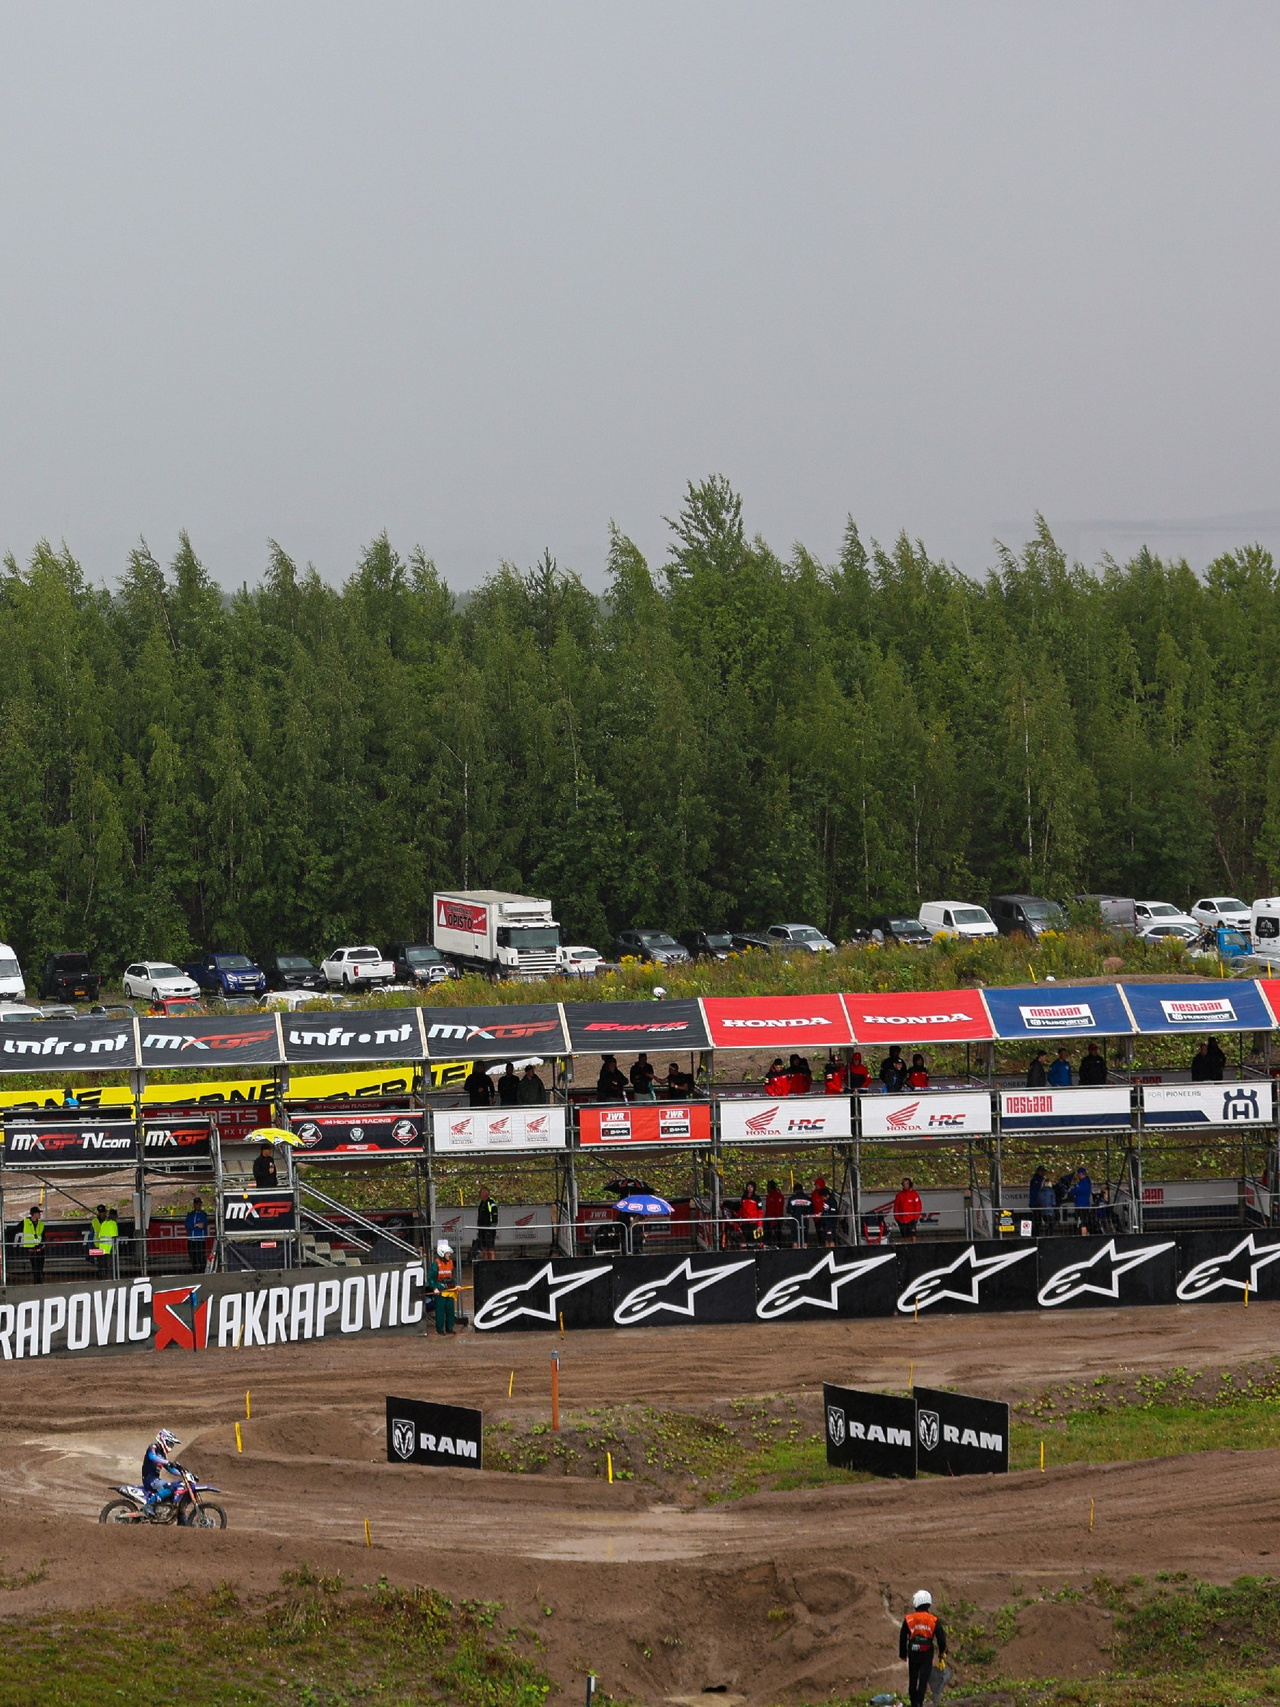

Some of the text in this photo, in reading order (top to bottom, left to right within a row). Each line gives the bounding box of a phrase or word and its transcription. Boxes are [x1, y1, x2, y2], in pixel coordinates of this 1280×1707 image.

[721, 1017, 832, 1028] HONDA
[862, 1013, 973, 1025] HONDA
[1006, 1096, 1053, 1113] nestaan
[787, 1118, 826, 1131] HRC
[928, 1114, 967, 1126] HRC
[219, 1261, 424, 1347] AKRAPOVIČ
[849, 1420, 911, 1447] RAM
[943, 1424, 1003, 1452] RAM
[420, 1432, 477, 1459] RAM
